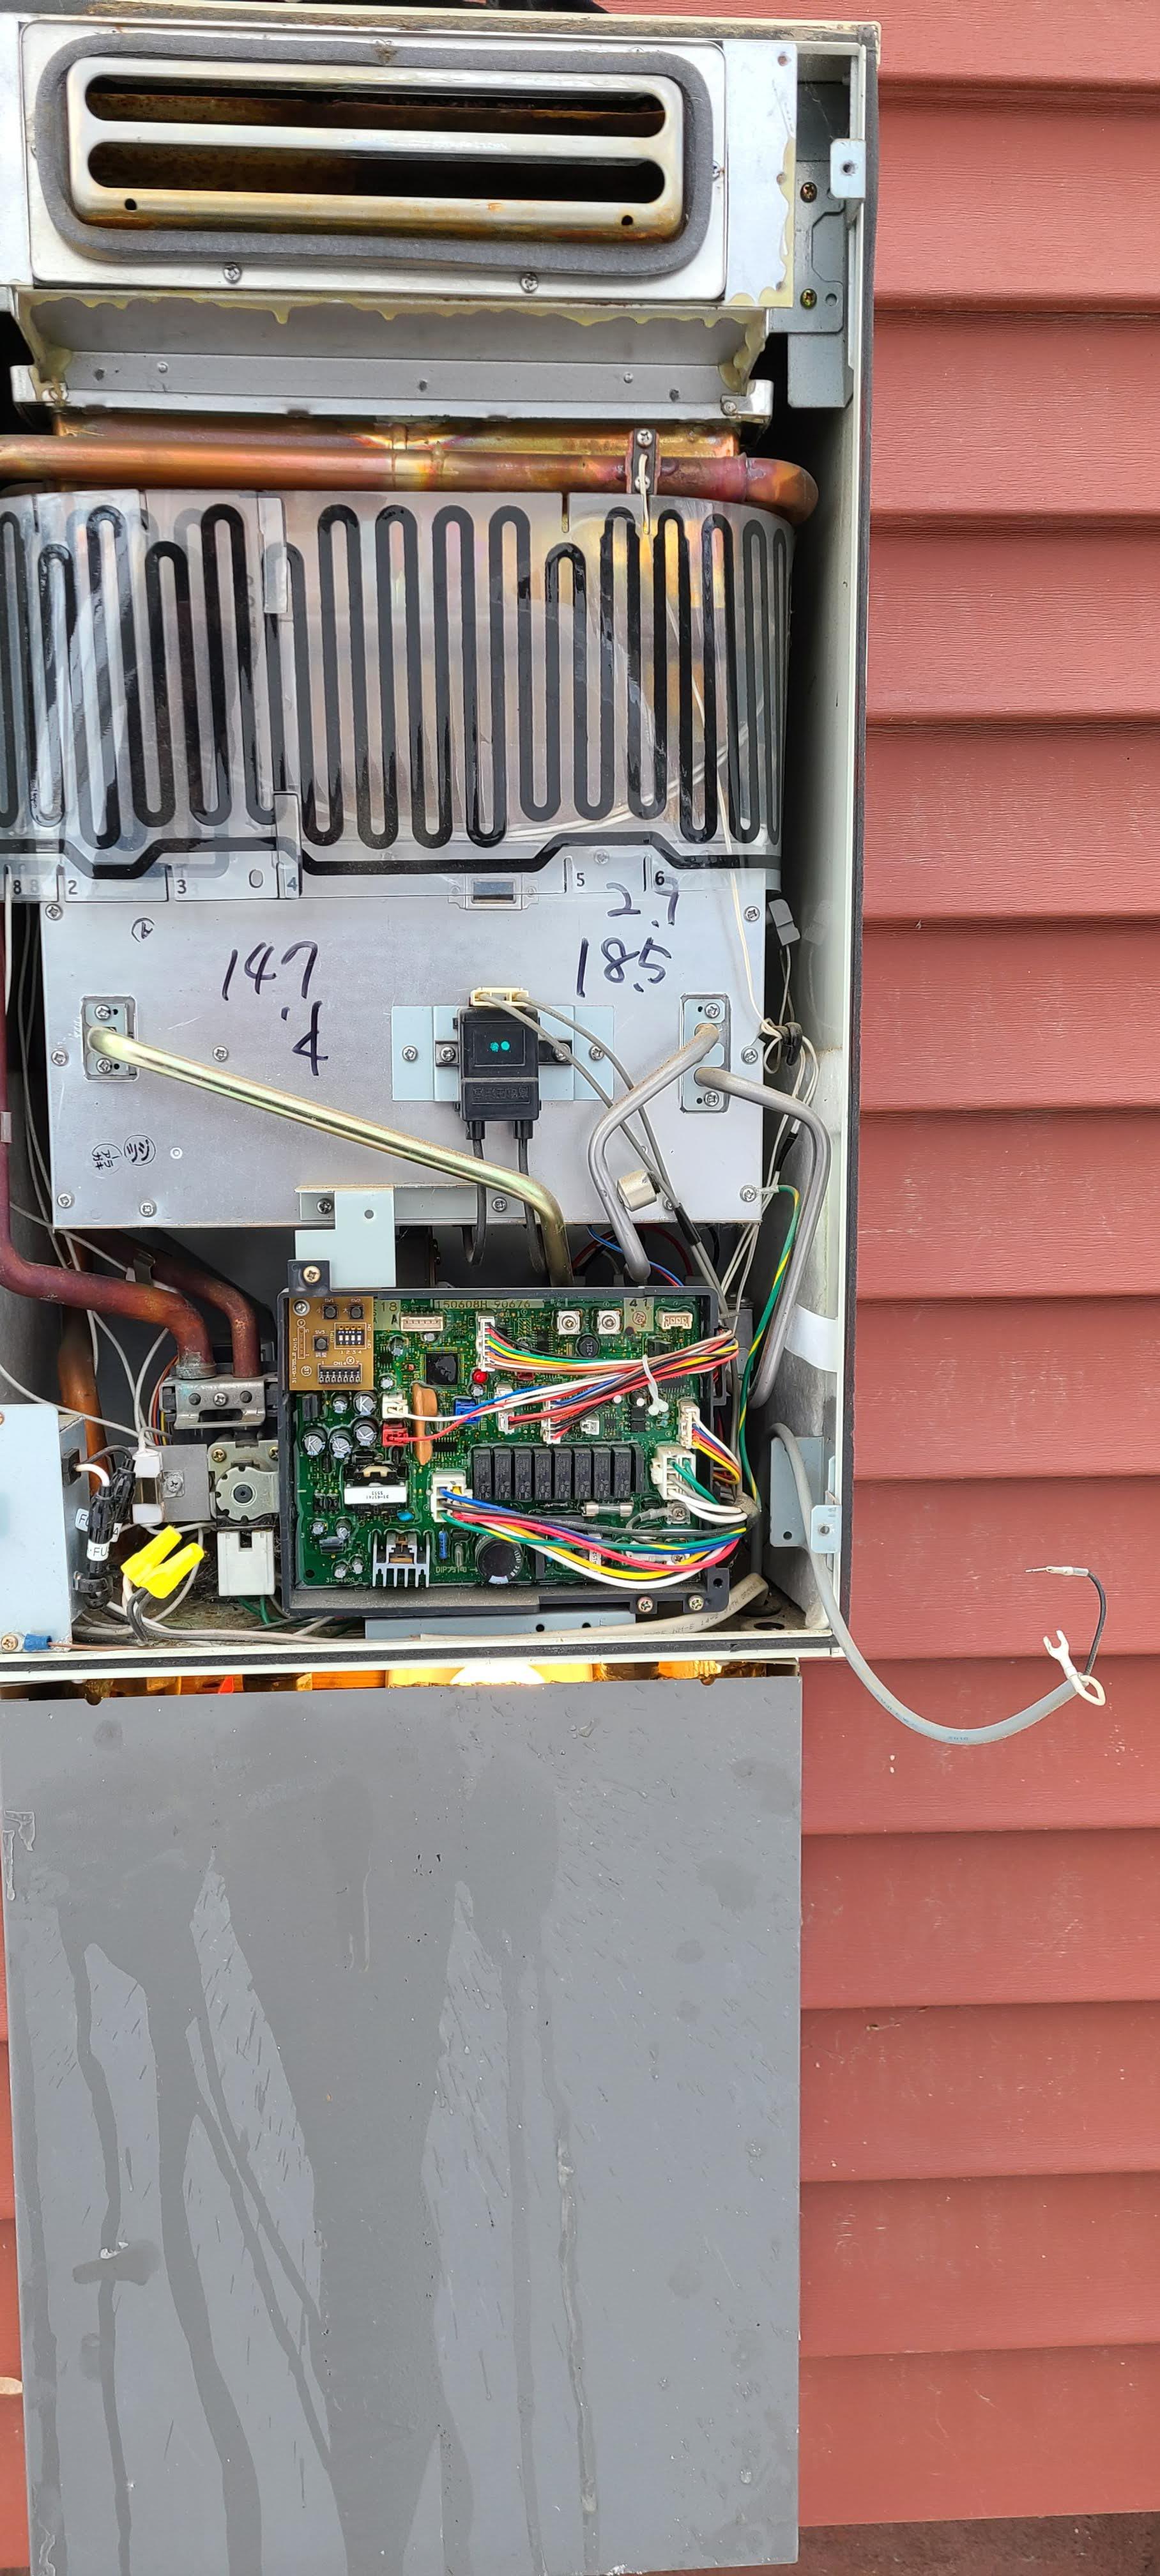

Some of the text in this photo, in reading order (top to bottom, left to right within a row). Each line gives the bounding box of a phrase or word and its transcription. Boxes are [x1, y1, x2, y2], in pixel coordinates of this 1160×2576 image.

[287, 877, 298, 891] 4
[576, 872, 585, 887] 5
[655, 870, 665, 886] 6
[13, 879, 22, 894] 8
[67, 880, 78, 894] 2
[176, 879, 187, 894] 3
[222, 940, 319, 1000] 147
[436, 1300, 531, 1308] 150608H 90676
